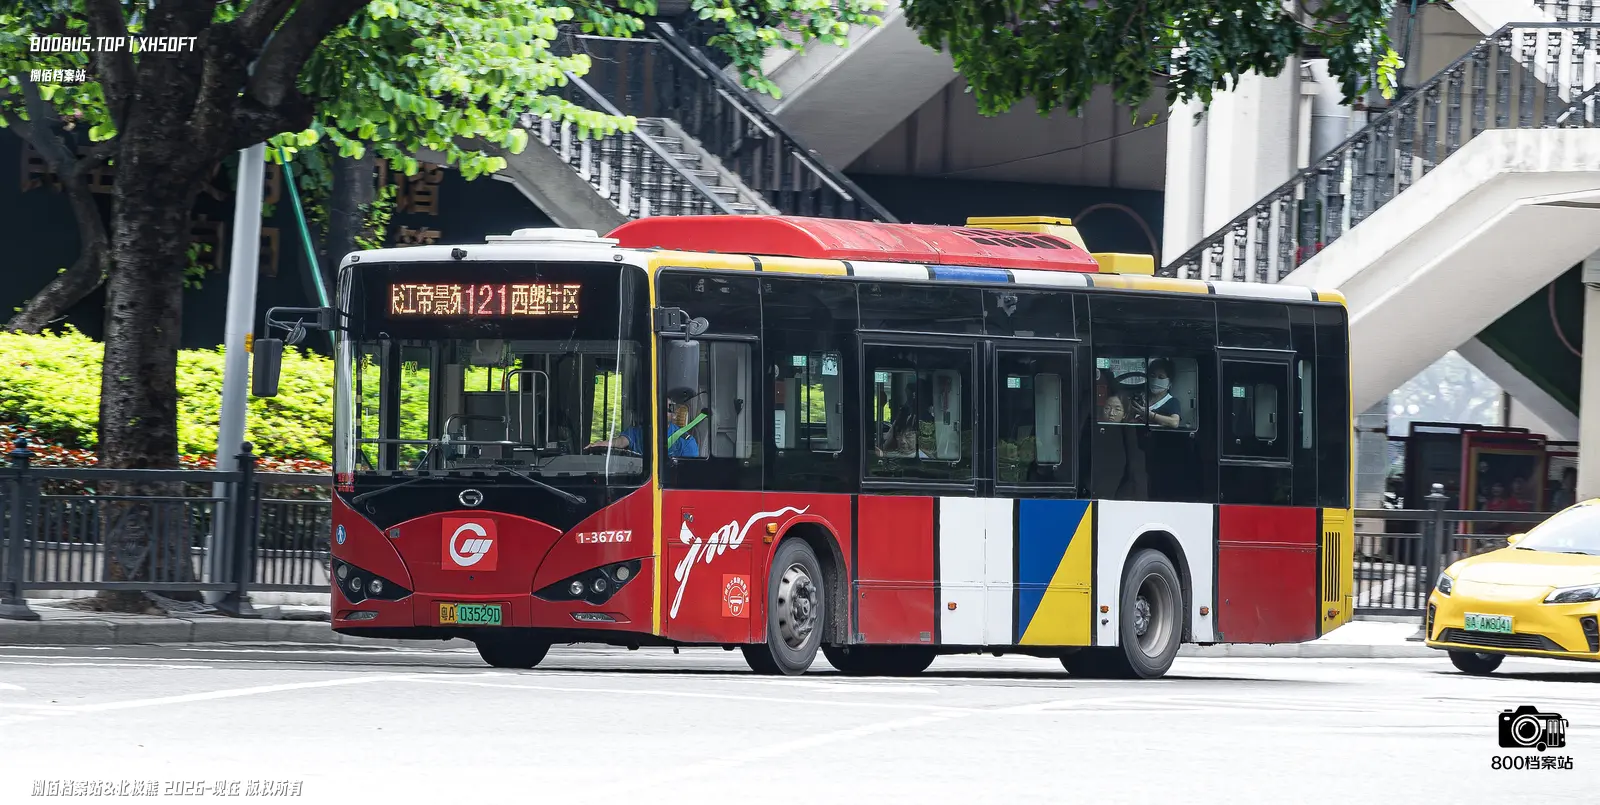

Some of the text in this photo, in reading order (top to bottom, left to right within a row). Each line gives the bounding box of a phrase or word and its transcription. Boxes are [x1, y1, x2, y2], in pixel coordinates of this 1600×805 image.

[466, 284, 506, 314] 121
[577, 529, 632, 544] 1-36767
[460, 606, 500, 622] 03529D
